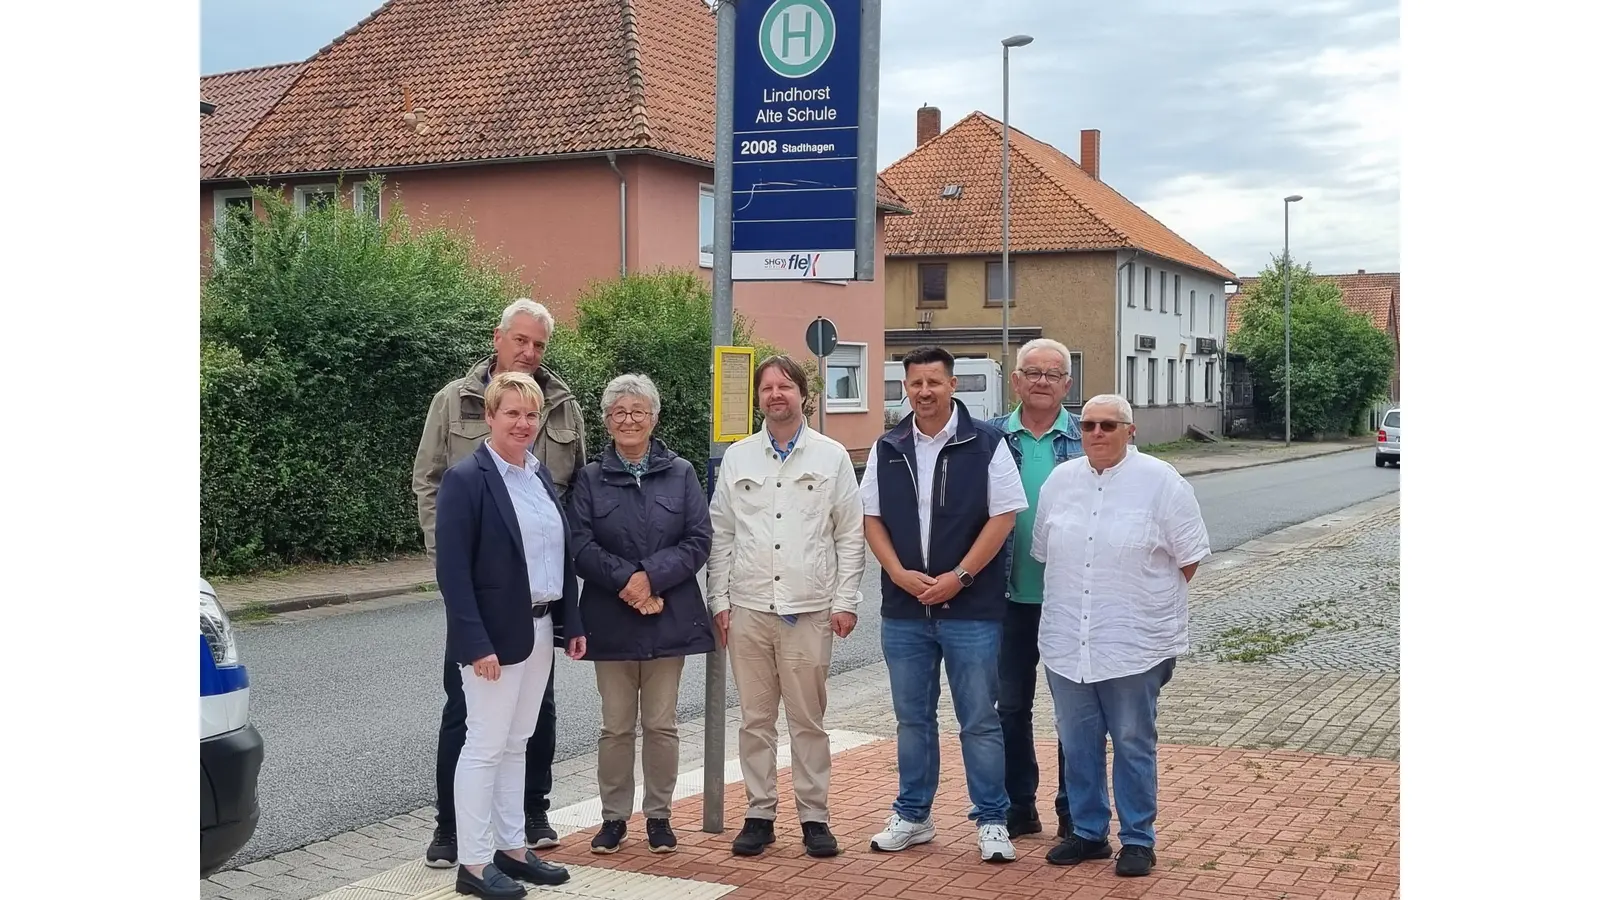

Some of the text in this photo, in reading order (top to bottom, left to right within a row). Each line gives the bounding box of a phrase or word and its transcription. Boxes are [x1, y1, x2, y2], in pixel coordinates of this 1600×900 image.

[781, 11, 812, 58] H
[763, 86, 831, 103] Lindhorst
[755, 106, 837, 123] Alte Schule
[741, 140, 835, 155] 2008 Stadthagen
